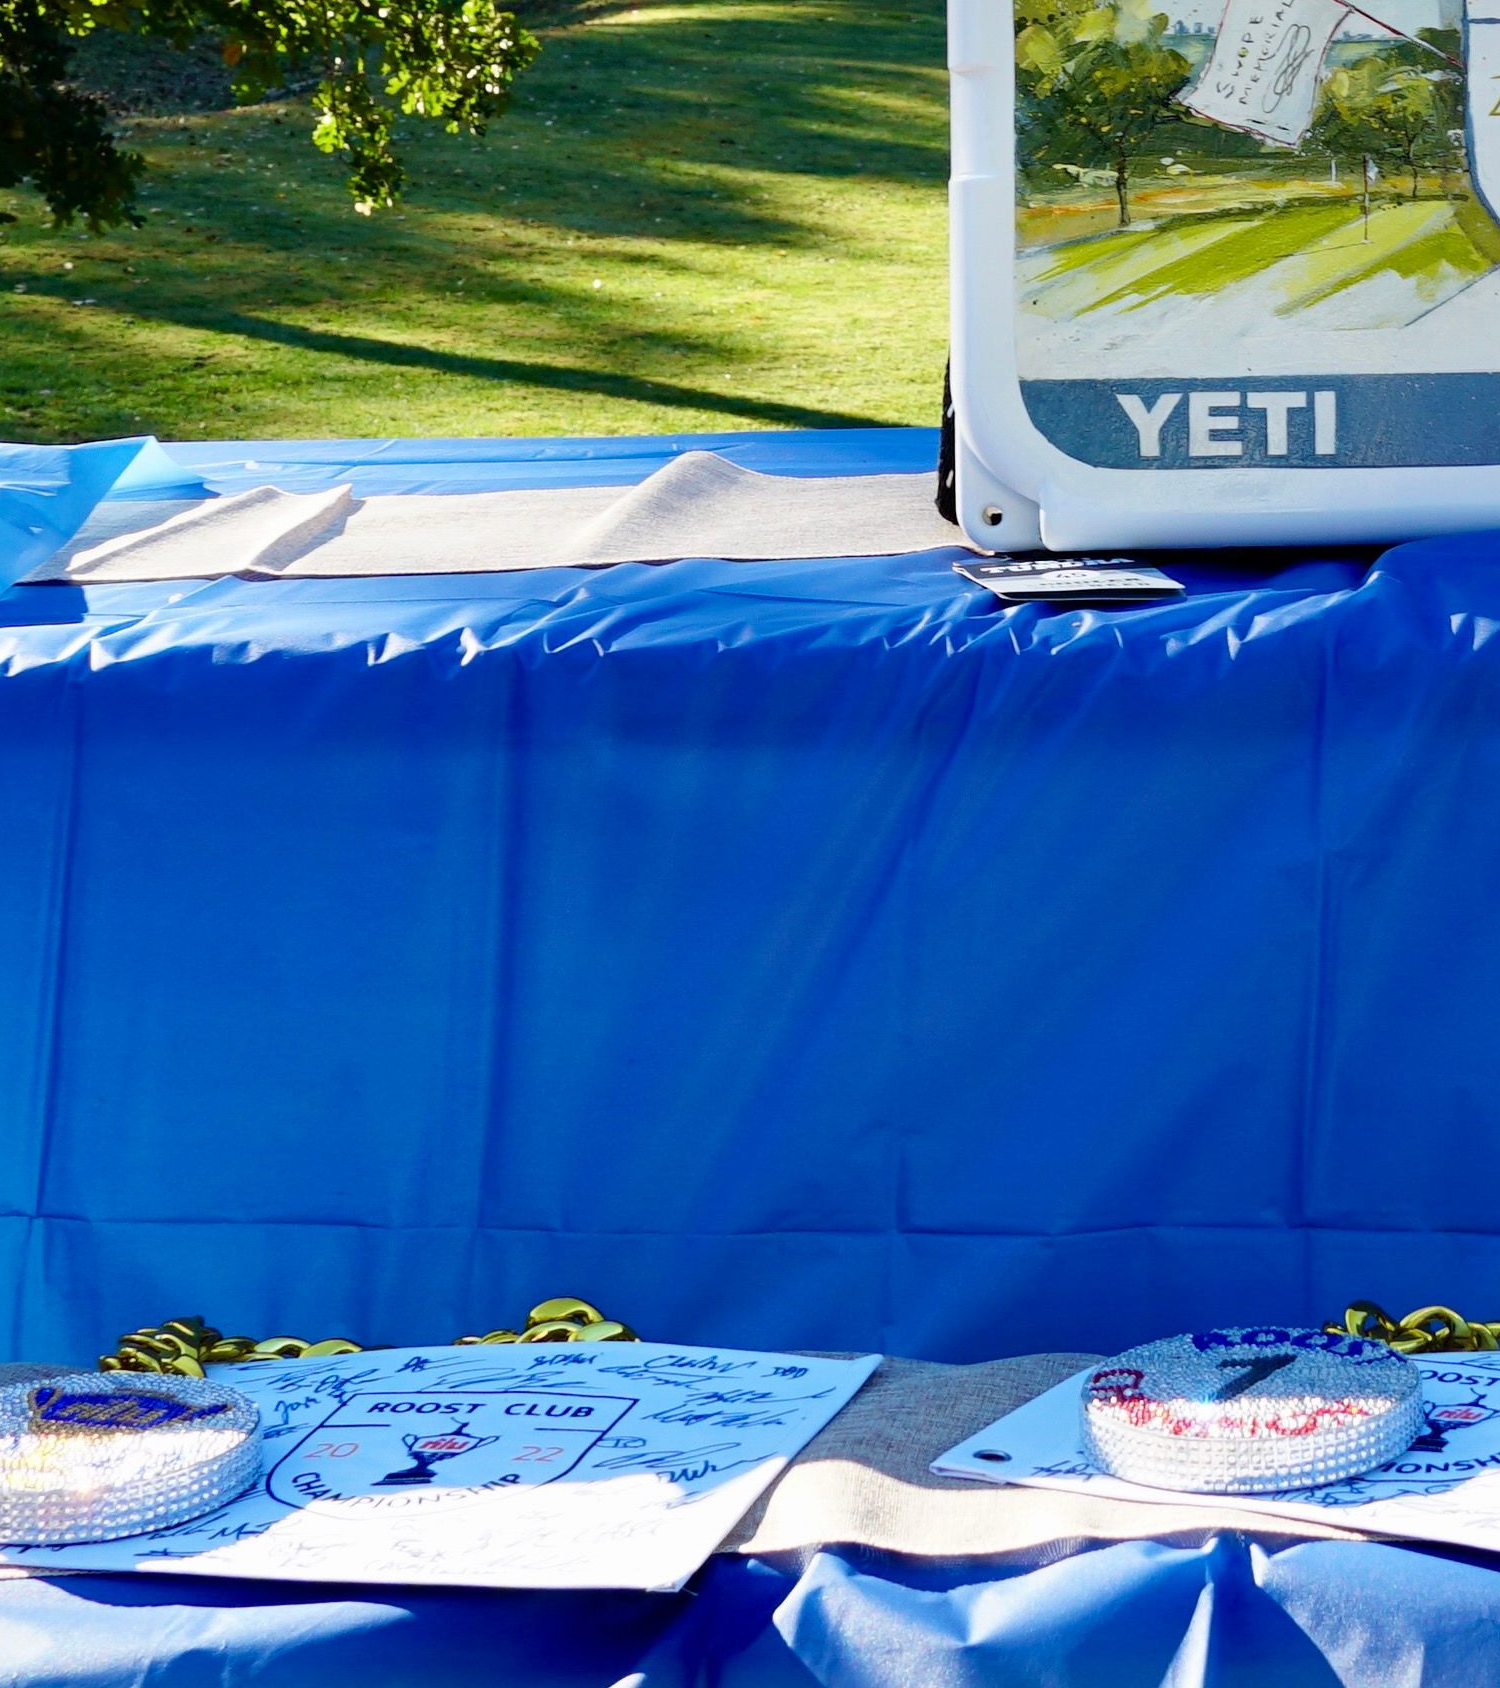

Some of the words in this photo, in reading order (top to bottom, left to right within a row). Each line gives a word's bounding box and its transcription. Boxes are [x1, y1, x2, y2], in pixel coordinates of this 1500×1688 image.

[1216, 15, 1263, 100] SWOPE
[1115, 391, 1337, 457] YETI
[1215, 1353, 1300, 1402] 7
[366, 1401, 488, 1415] ROOST
[504, 1402, 597, 1418] CLUB
[302, 1441, 360, 1459] 20
[511, 1445, 566, 1463] 22
[291, 1471, 522, 1509] CHAMPIONSHIP
